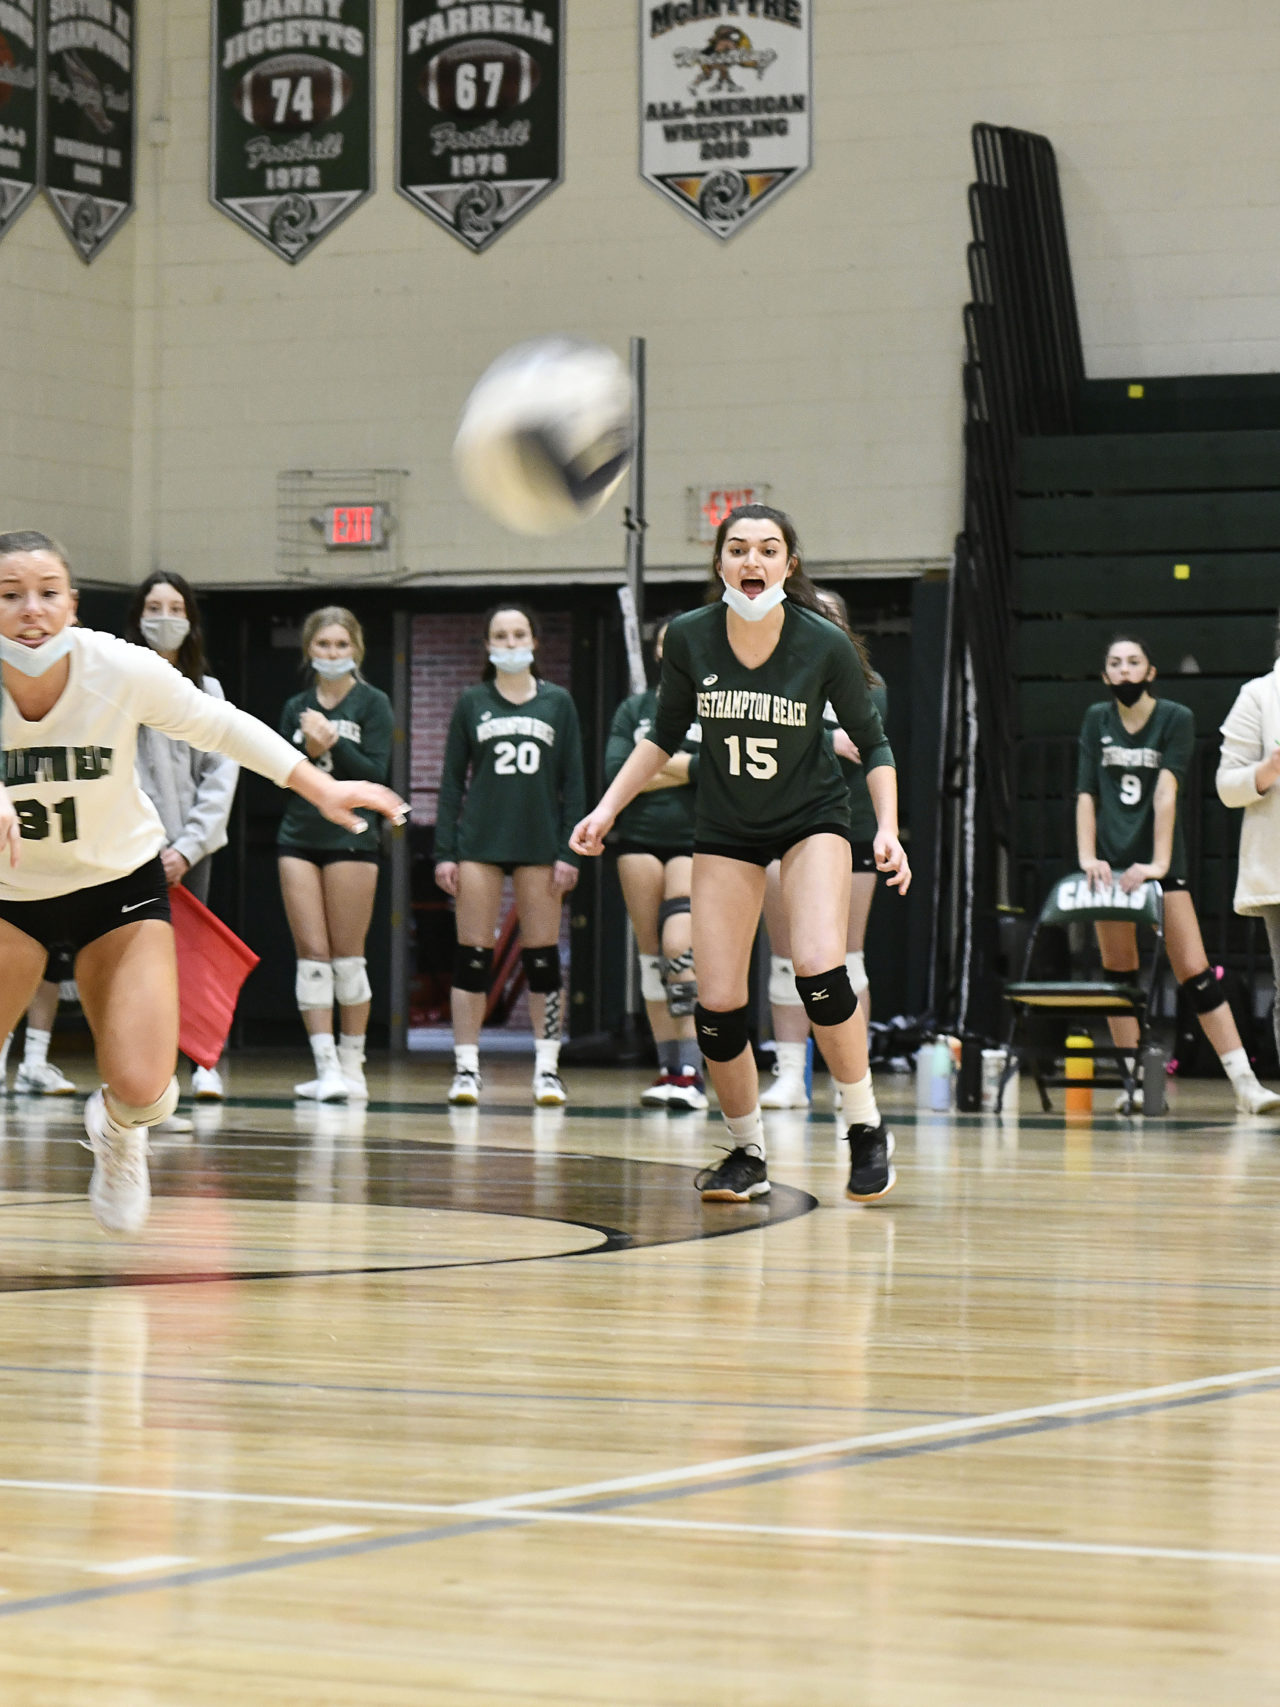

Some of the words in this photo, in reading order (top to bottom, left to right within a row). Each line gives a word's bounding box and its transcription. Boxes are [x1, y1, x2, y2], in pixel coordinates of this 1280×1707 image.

[242, 0, 342, 27] DANNY
[407, 3, 553, 54] FARRELL
[223, 19, 364, 69] JIGGETTS
[271, 76, 313, 123] 74
[455, 62, 504, 110] 67
[646, 95, 805, 121] ALL-AMERICAN
[663, 118, 788, 143] WRESTLING
[333, 506, 374, 543] EXIT
[772, 695, 807, 727] BEACH
[493, 741, 541, 775] 20
[724, 735, 778, 780] 15
[1119, 773, 1142, 805] 9
